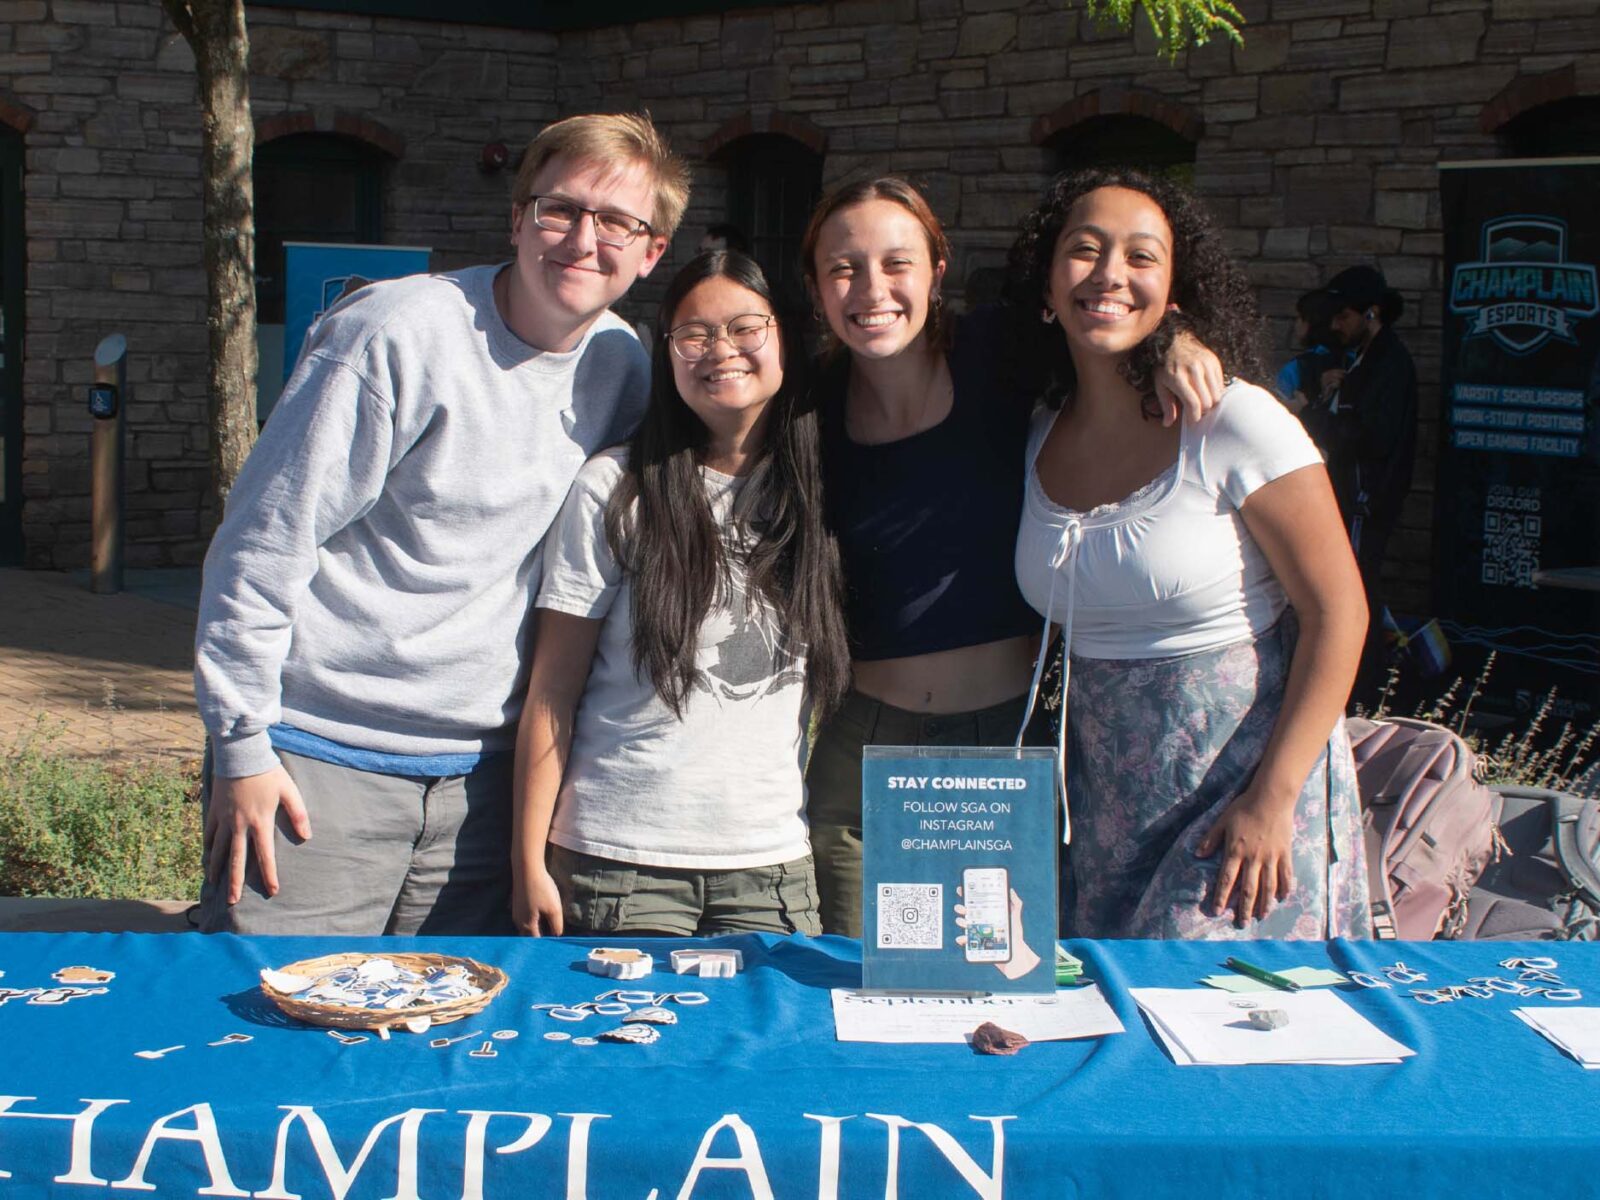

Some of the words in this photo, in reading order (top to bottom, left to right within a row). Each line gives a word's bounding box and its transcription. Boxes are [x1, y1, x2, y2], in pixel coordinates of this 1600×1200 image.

[1455, 267, 1593, 304] CHAMPLAIN
[1487, 305, 1558, 327] ESPORTS
[1455, 384, 1499, 401] VARSITY
[1502, 387, 1584, 408] SCHOLARSHIPS
[1453, 407, 1523, 426] WORK-STUDY
[1527, 412, 1585, 431] POSITIONS
[1456, 430, 1485, 447] OPEN
[1487, 433, 1529, 450] GAMING
[1530, 436, 1579, 454] FACILITY
[1487, 495, 1541, 512] DISCORD
[887, 776, 928, 790] STAY
[931, 777, 1027, 791] CONNECTED
[903, 801, 958, 814] FOLLOW
[961, 802, 987, 814] SGA
[990, 802, 1011, 814] ON
[919, 819, 994, 831] INSTAGRAM
[901, 838, 1013, 851] @CHAMPLAINSGA
